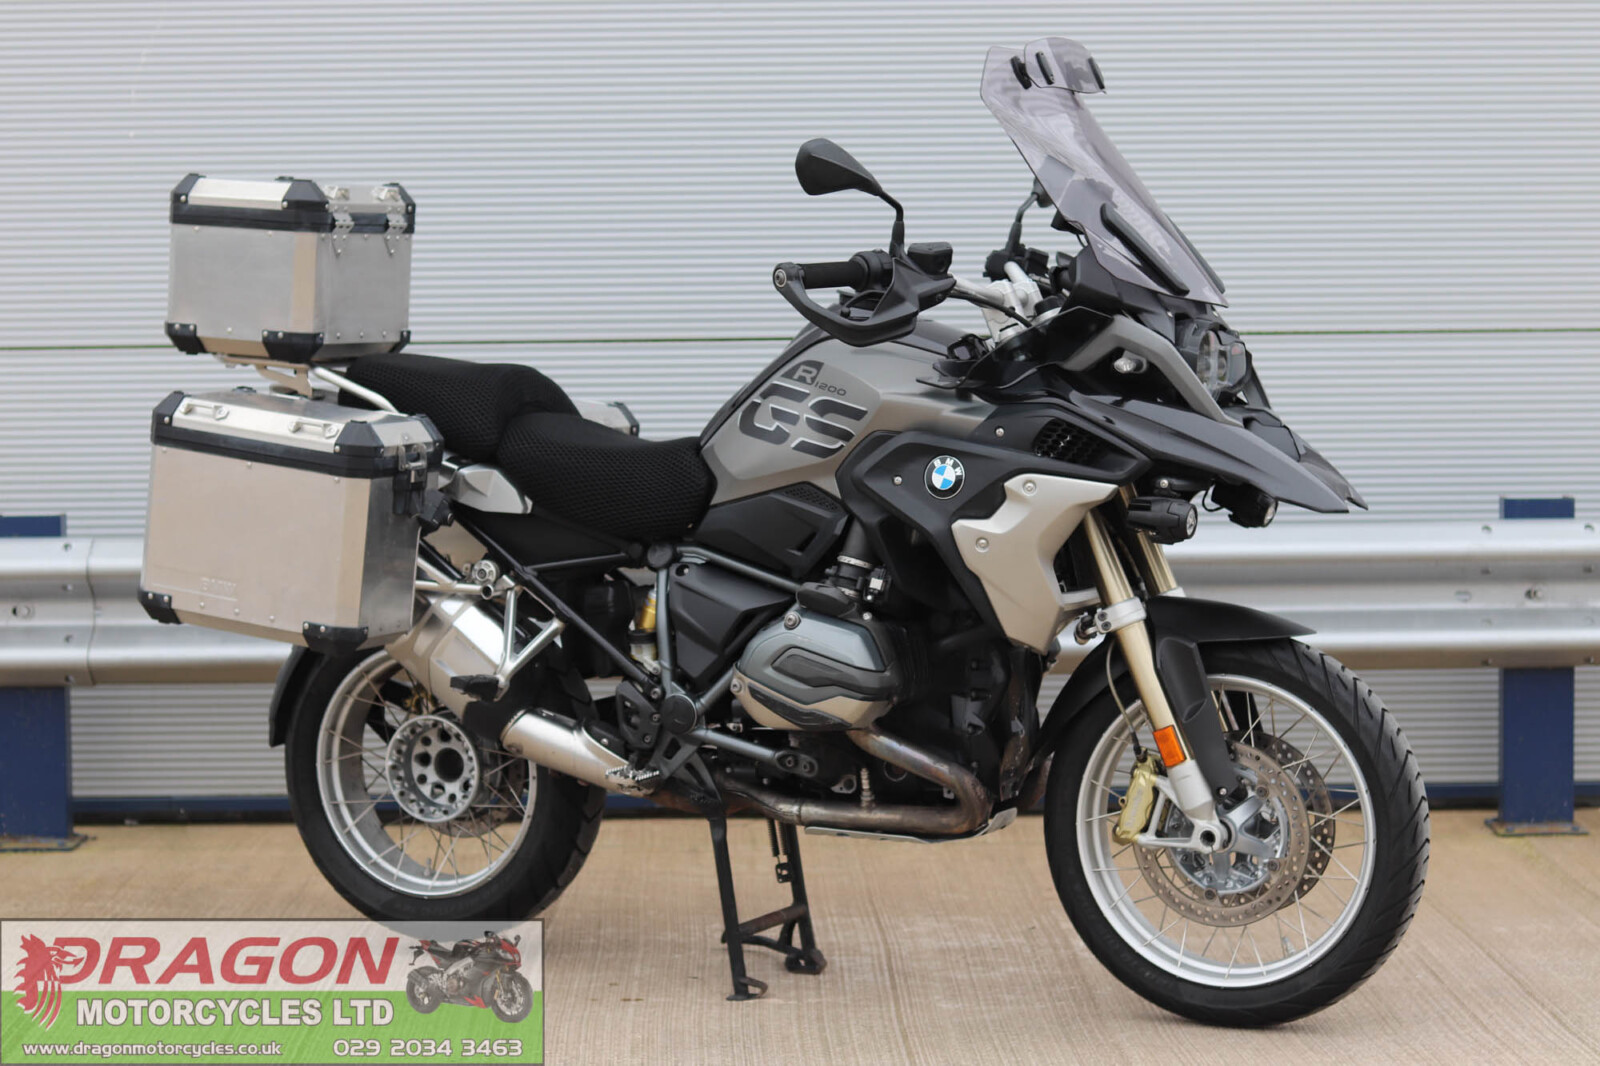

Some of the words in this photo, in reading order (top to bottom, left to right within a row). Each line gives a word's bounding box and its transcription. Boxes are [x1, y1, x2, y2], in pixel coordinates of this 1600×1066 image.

[793, 365, 817, 384] R
[815, 381, 847, 396] 1200
[738, 381, 868, 458] GS
[933, 457, 963, 476] BMW
